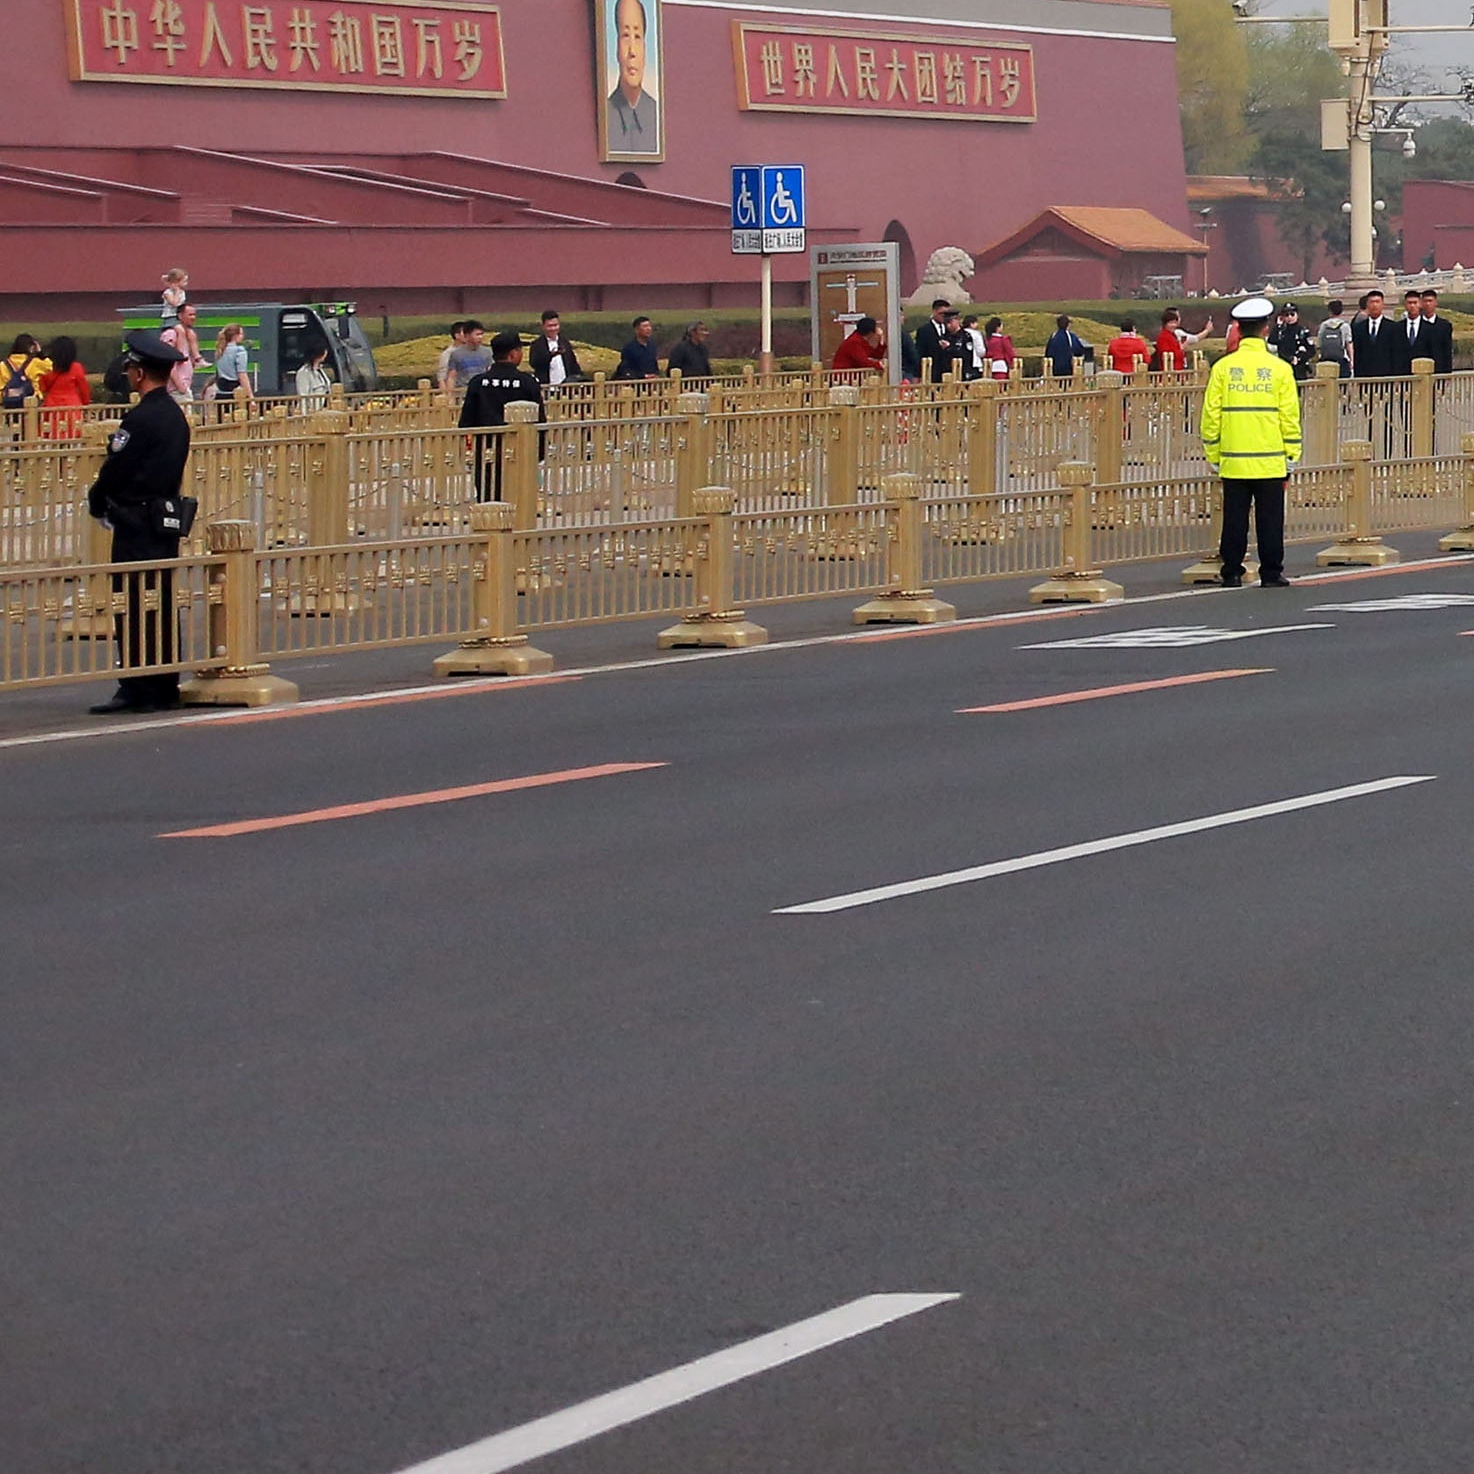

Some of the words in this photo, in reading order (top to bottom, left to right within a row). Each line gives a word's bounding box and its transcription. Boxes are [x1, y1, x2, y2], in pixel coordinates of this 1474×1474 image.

[759, 40, 1020, 110] 世界人民大团结万岁
[1229, 367, 1273, 382] 警察
[1227, 382, 1273, 393] POLICE
